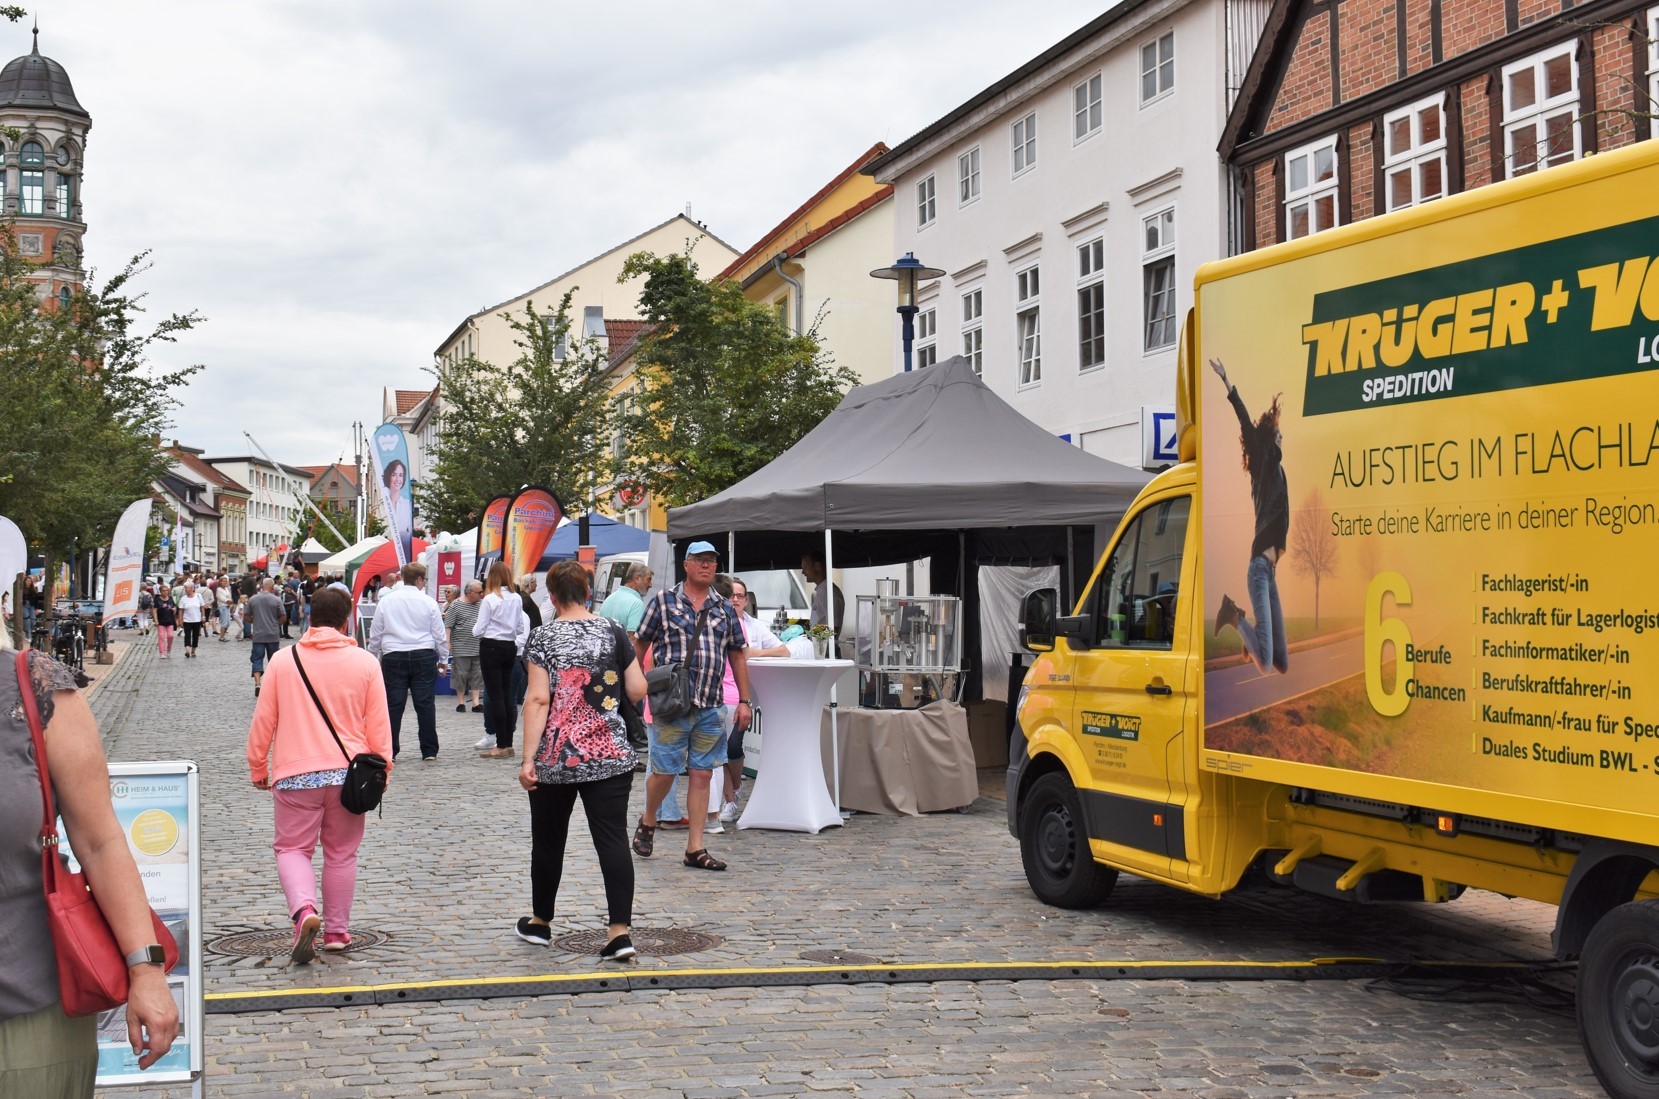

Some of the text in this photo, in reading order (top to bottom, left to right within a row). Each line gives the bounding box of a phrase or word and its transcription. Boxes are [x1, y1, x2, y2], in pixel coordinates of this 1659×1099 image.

[1302, 281, 1536, 377] KRÜGER
[1362, 366, 1455, 403] SPEDITION
[1330, 440, 1459, 489] AUFSTIEG
[1470, 435, 1502, 480] IM
[1331, 509, 1373, 537] Starte
[1377, 507, 1419, 536] deine
[1425, 505, 1491, 534] Karriere
[1497, 502, 1512, 530] in
[1517, 499, 1579, 529] deiner
[1481, 572, 1590, 598] Fachlagerist/-in
[1481, 606, 1547, 627] Fachkraft
[1550, 606, 1573, 628] für
[1363, 570, 1414, 718] 6
[1404, 643, 1452, 666] Berufe
[1481, 638, 1630, 665] Fachinformatiker/-in
[1404, 678, 1466, 703] Chancen
[1481, 671, 1631, 701] Berufskraftfahrer/-in
[1082, 712, 1111, 728] KRÜGER
[1481, 704, 1592, 733] Kaufmann/-frau
[1596, 714, 1619, 735] für
[1481, 737, 1529, 761] Duales
[1532, 741, 1594, 768] Studium
[1599, 749, 1638, 773] BWL
